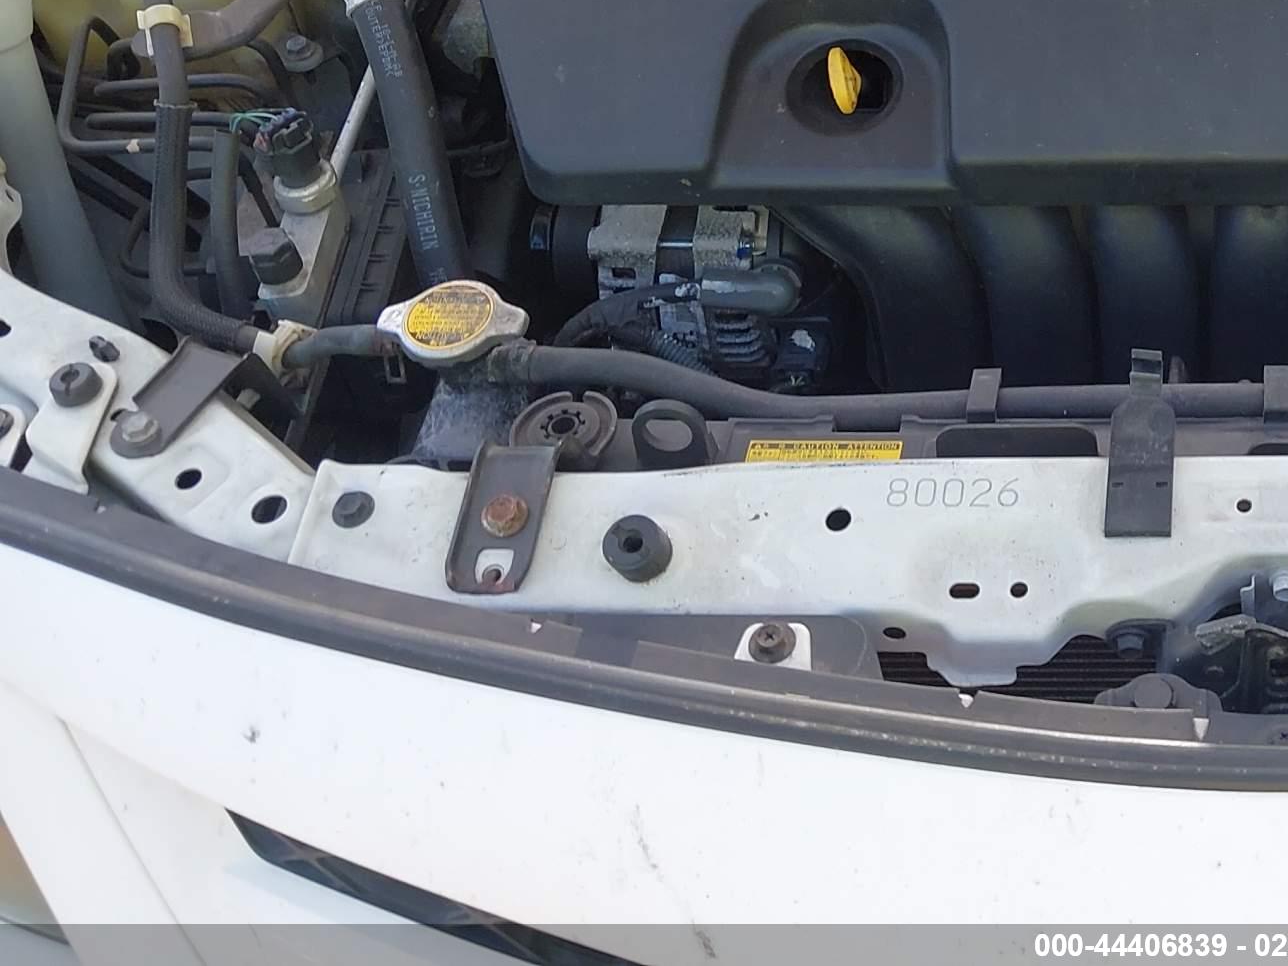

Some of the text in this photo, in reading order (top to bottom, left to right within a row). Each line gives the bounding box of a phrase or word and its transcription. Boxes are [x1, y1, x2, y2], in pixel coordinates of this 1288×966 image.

[793, 442, 898, 450] CAUTION ATTENTION
[886, 477, 1020, 508] 80026
